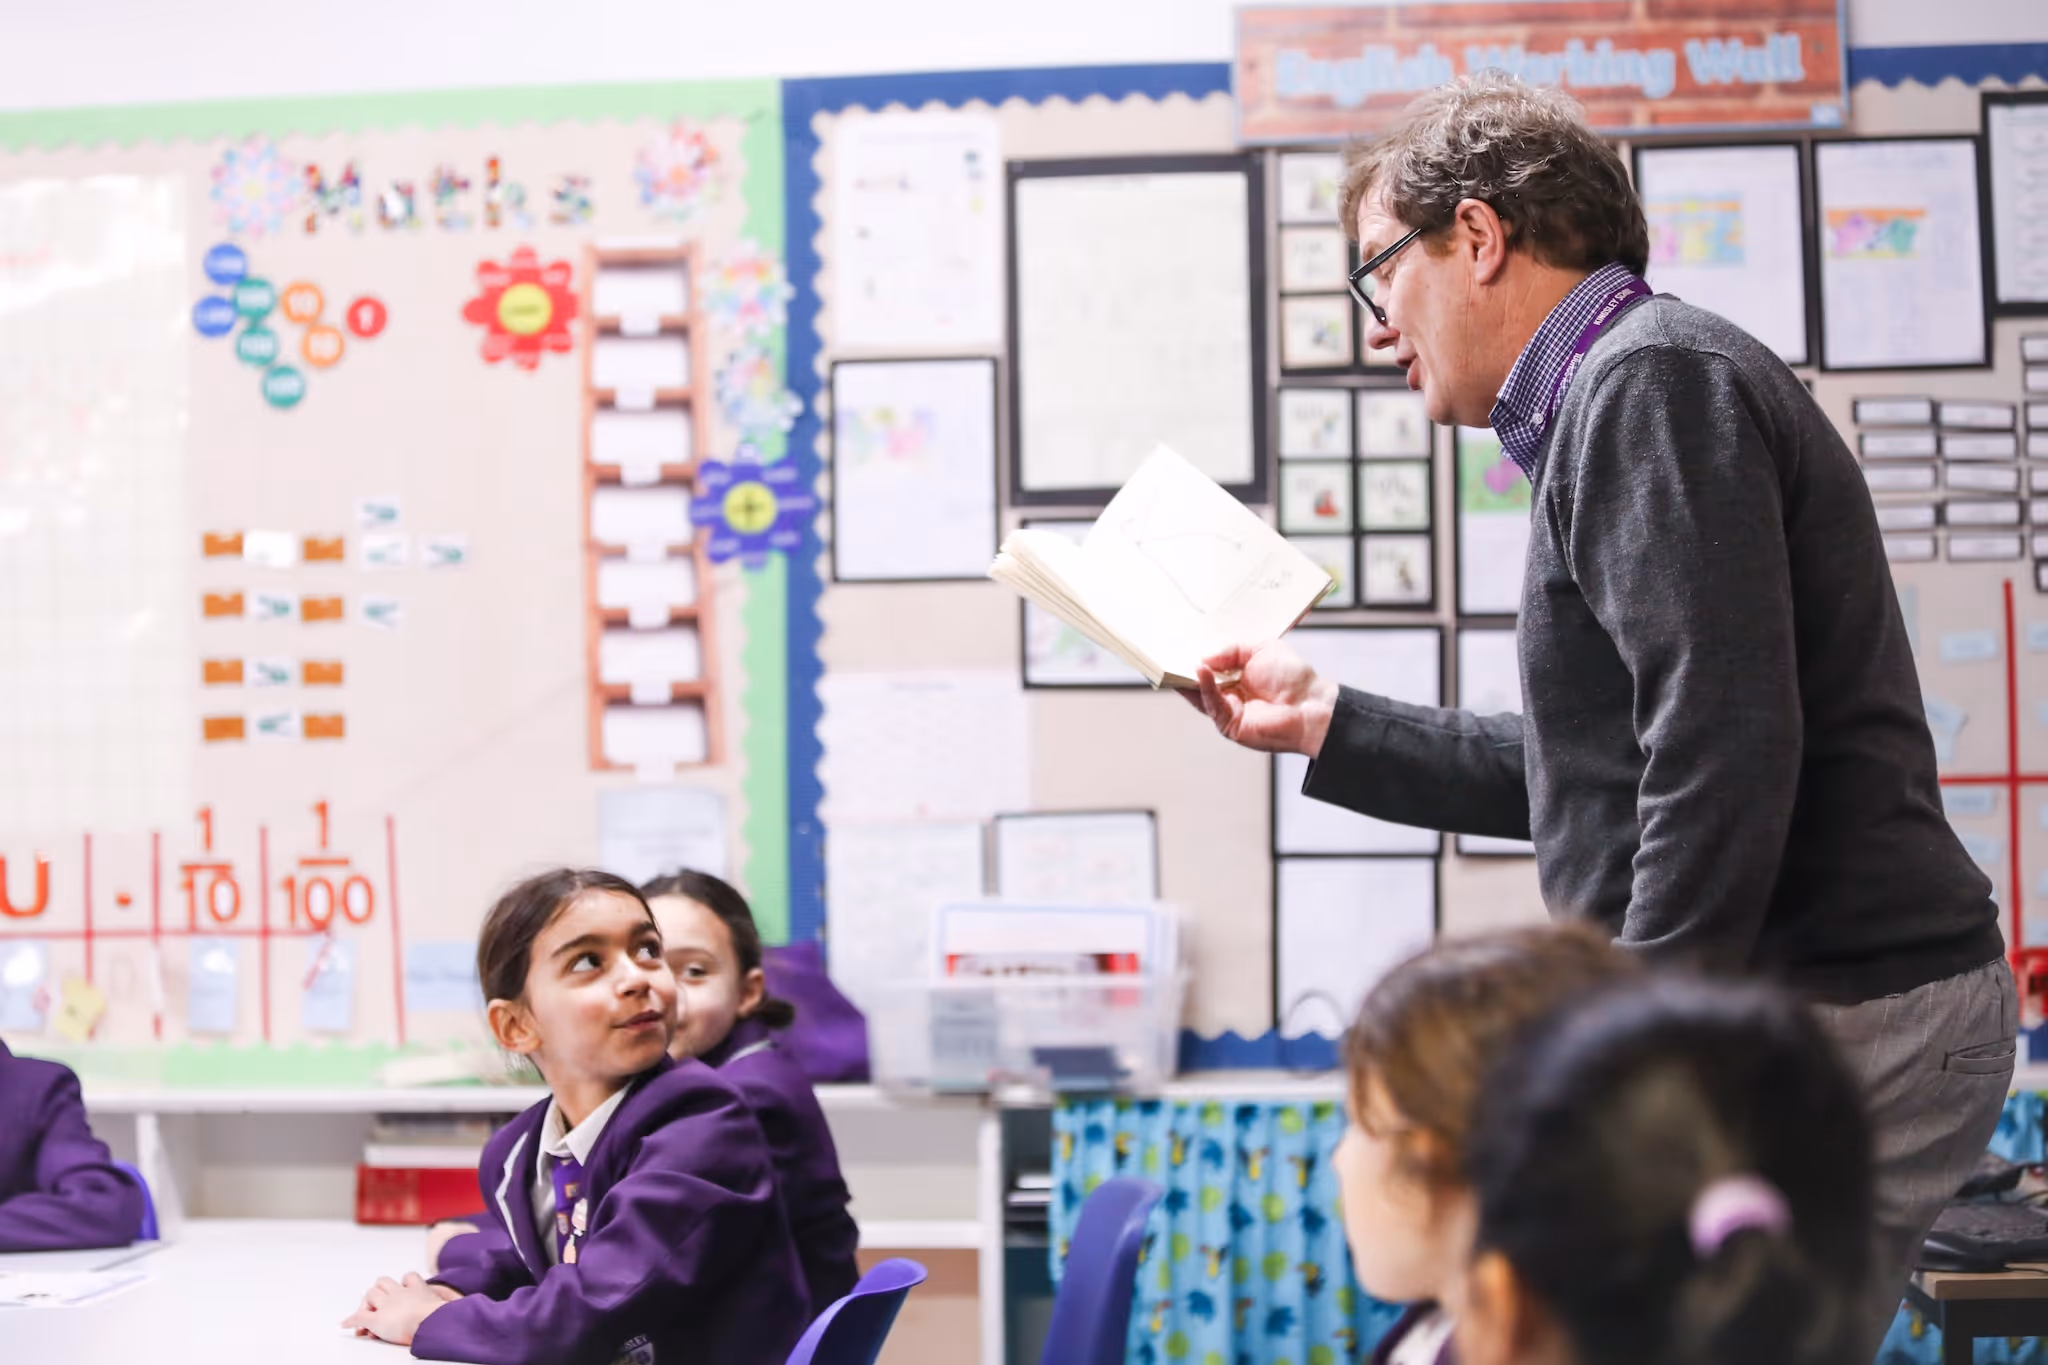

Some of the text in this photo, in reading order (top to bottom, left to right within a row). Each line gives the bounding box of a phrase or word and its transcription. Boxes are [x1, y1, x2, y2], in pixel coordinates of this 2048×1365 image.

[1274, 32, 1805, 107] English Working Wall
[303, 155, 596, 236] Maths
[1593, 298, 1619, 325] KINGSLEY
[0, 851, 50, 918] U
[181, 868, 241, 931] 10
[281, 874, 375, 929] 100
